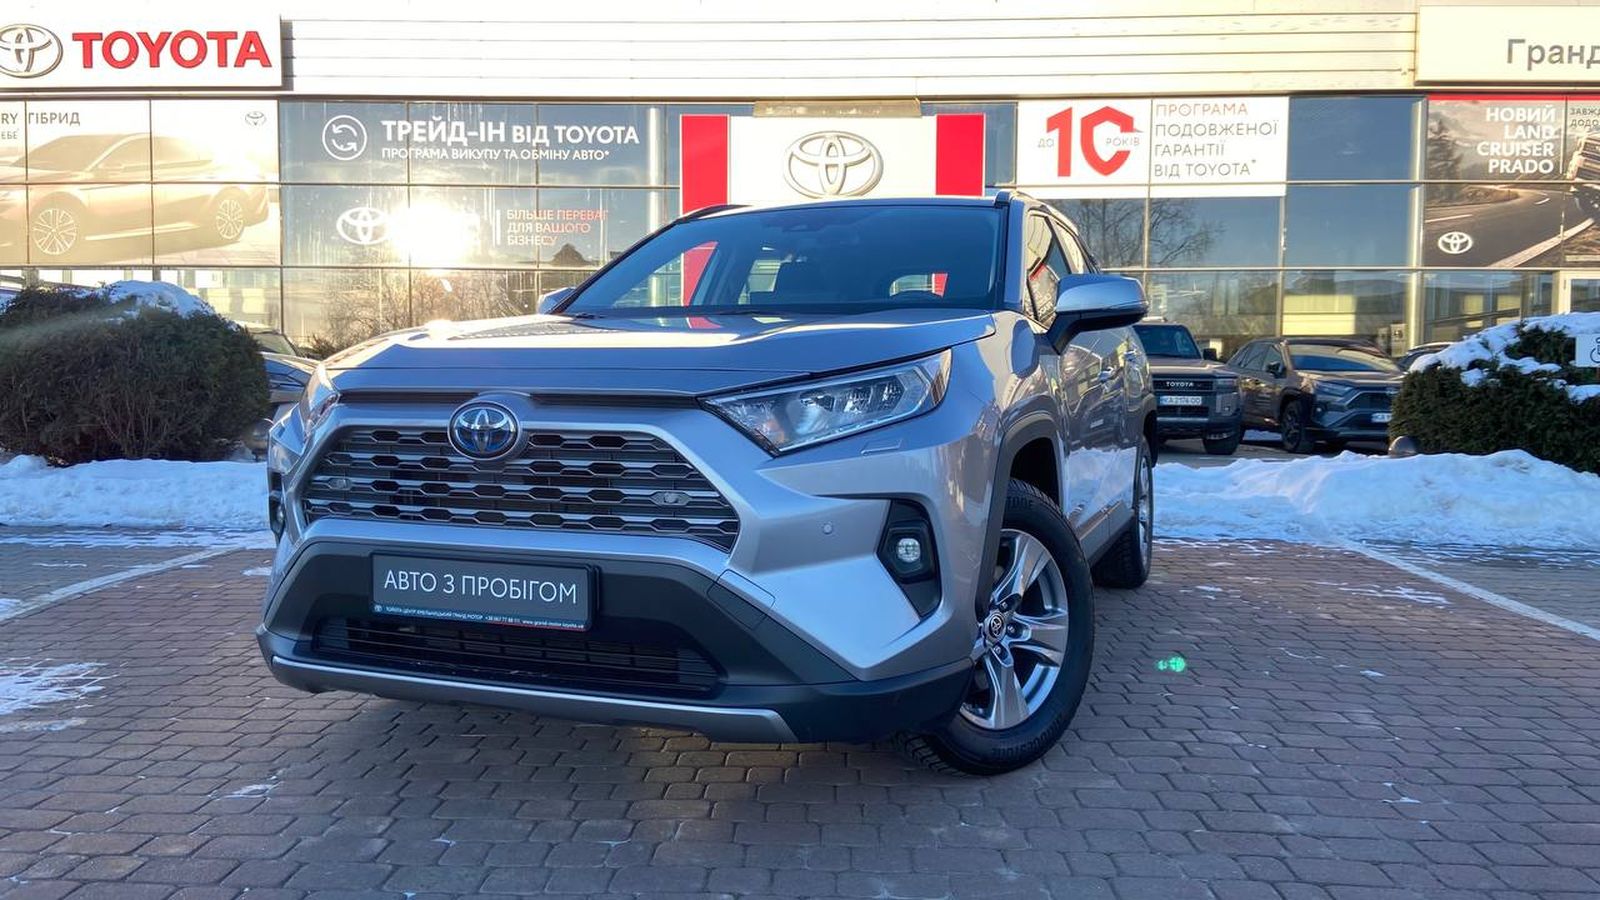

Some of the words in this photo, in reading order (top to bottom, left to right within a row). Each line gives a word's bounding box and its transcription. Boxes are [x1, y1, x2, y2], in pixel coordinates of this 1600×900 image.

[72, 30, 272, 69] TOYOTA
[1156, 103, 1248, 117] ПРОГРАМА
[1486, 105, 1556, 122] НОВИЙ
[28, 112, 81, 126] ГІБРИД
[380, 116, 506, 146] ТРЕЙД-ІН
[512, 125, 549, 147] ВІД
[554, 125, 640, 144] TOYOTA
[1155, 119, 1279, 138] ПОДОВЖЕНОЇ
[1504, 125, 1554, 139] LAND
[1037, 138, 1055, 148] ДО
[1105, 137, 1140, 147] РОКІВ
[1154, 139, 1226, 157] ГАРАНТІЇ
[1476, 141, 1555, 157] CRUISER
[382, 148, 448, 159] ПРОГРАМА
[451, 148, 501, 160] ВИКУПУ
[503, 149, 519, 160] ТА
[520, 149, 571, 160] ОБМІНУ
[1154, 163, 1180, 179] ВІД
[1488, 159, 1554, 174] PRADO
[506, 209, 554, 221] БІЛЬШЕ
[556, 209, 608, 221] ПЕРЕВАГ
[507, 222, 533, 234] ДЛЯ
[535, 222, 591, 234] ВАШОГО
[507, 235, 557, 247] БІЗНЕСУ
[384, 569, 437, 593] АВТО
[443, 574, 455, 594] З
[461, 575, 577, 604] ПРОБІГОМ
